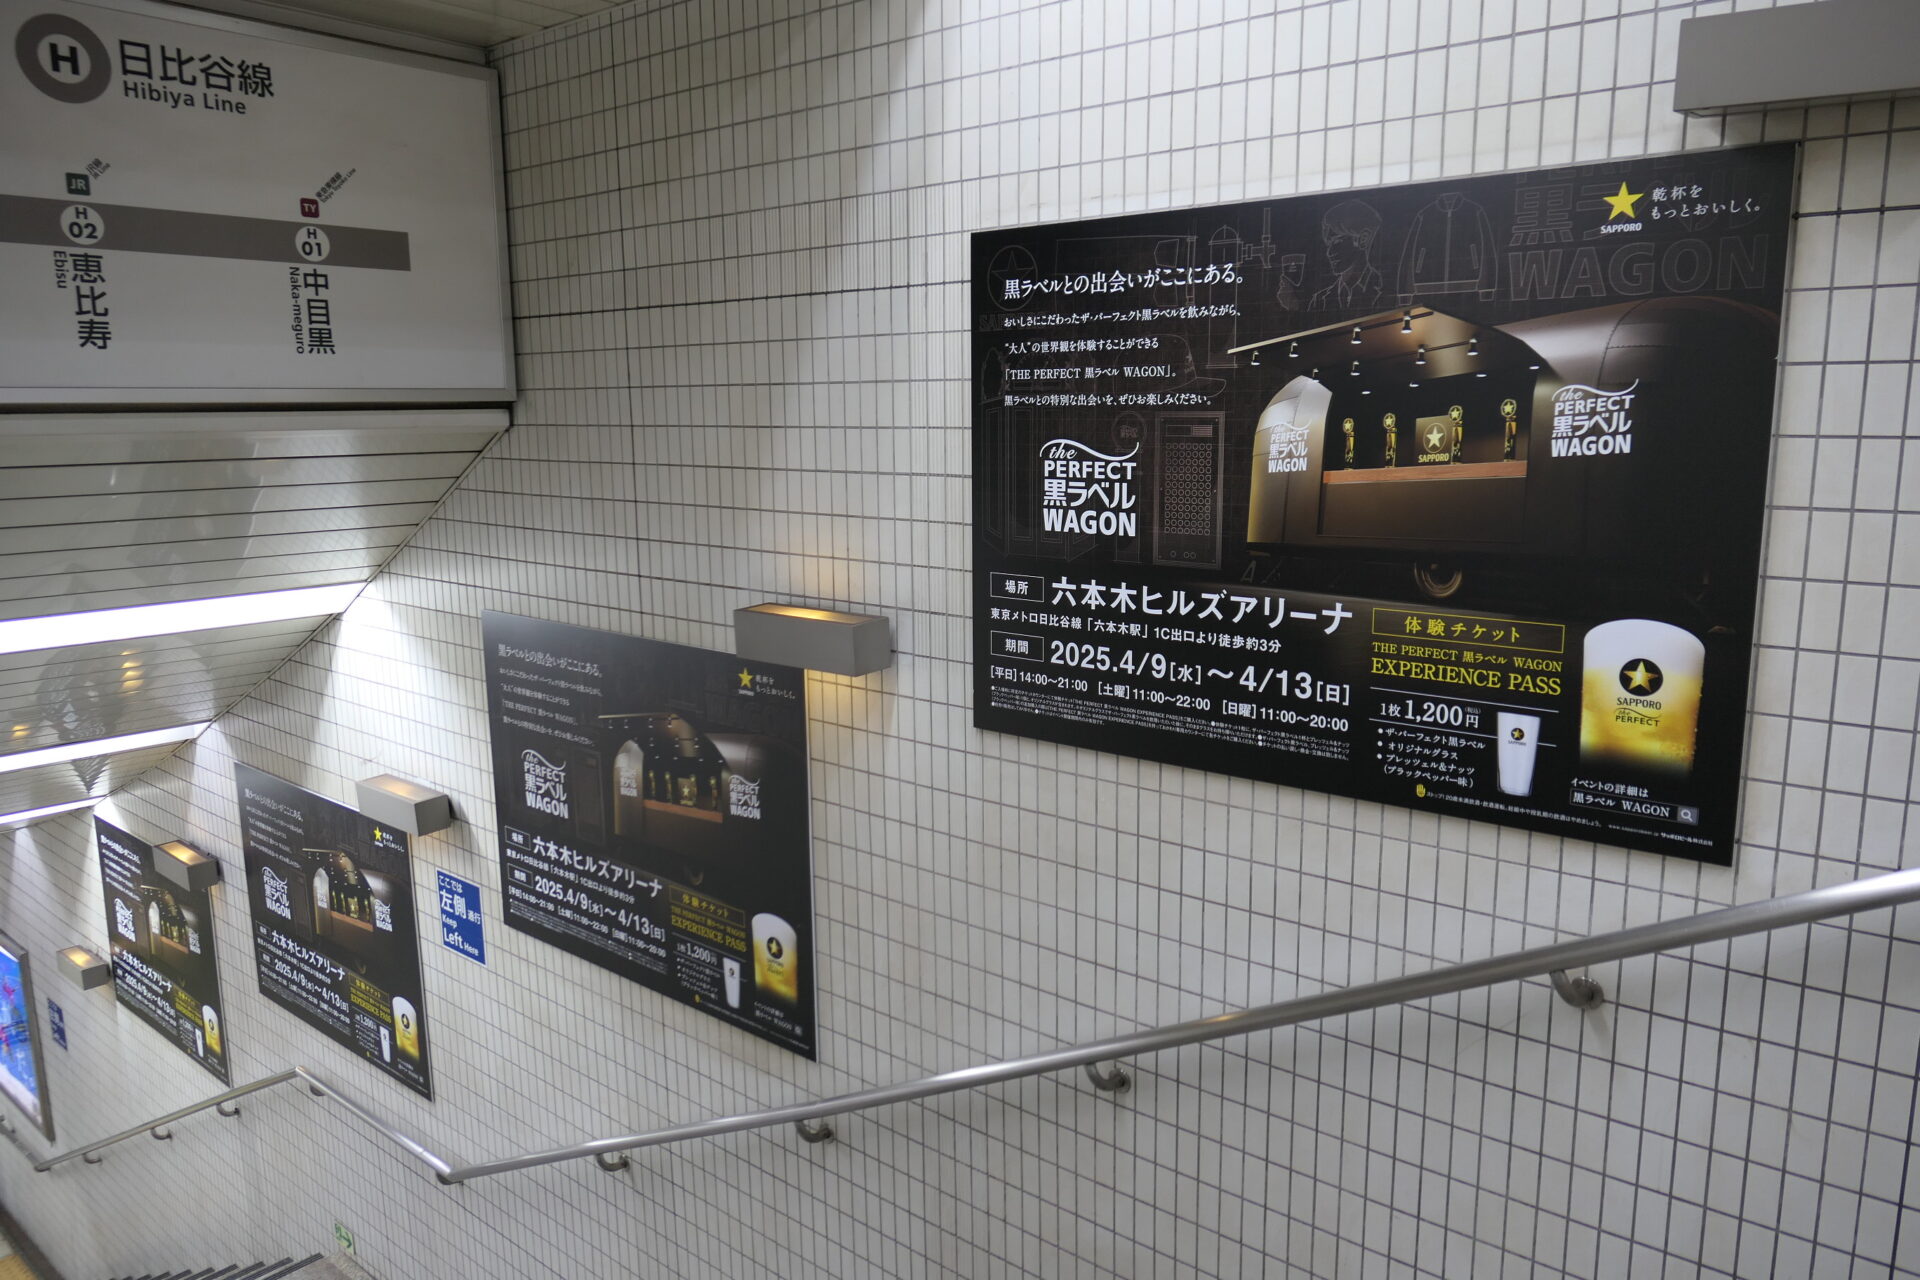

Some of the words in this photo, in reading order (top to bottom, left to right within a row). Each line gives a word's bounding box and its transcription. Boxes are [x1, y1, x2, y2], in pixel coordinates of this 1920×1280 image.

[48, 42, 80, 76] H
[118, 39, 275, 98] 日比谷線
[123, 81, 195, 108] Hibiya
[203, 93, 247, 115] Line
[69, 177, 88, 192] JR
[1652, 184, 1703, 202] 乾杯を
[76, 207, 88, 220] H
[302, 203, 318, 214] TY
[1651, 199, 1761, 220] もっとおいしく。
[69, 222, 98, 240] 02
[306, 228, 318, 239] H
[1601, 222, 1642, 234] SAPPORO
[301, 242, 323, 257] 01
[53, 251, 67, 290] Ebisu
[1508, 234, 1768, 301] WAGON
[1004, 262, 1244, 300] 黒ラベルとの出会いがここにある。
[69, 252, 112, 350] 恵比寿
[288, 266, 305, 355] Naka-meguro
[302, 268, 336, 356] 中目黒
[1034, 367, 1081, 380] PERFECT
[1084, 366, 1120, 379] 黒ラベル
[1553, 395, 1635, 415] PERFECT
[1551, 412, 1632, 438] 黒ラベル
[1269, 429, 1310, 444] PERFECT
[1550, 434, 1632, 458] WAGON
[1048, 442, 1077, 459] the
[1268, 442, 1309, 459] 黒ラベル
[1417, 453, 1450, 464] SAPPORO
[1044, 460, 1137, 480] PERFECT
[1267, 459, 1308, 473] WAGON
[1043, 478, 1136, 509] 黒ラベル
[1043, 508, 1137, 537] WAGON
[1005, 580, 1029, 595] 場所
[1052, 576, 1353, 635] 六本木ヒルズアリーナ
[1404, 615, 1521, 643] 体験チケット
[1005, 638, 1030, 655] 期間
[1372, 641, 1398, 655] THE
[1401, 644, 1458, 660] PERFECT
[1462, 650, 1507, 665] 黒ラベル
[1513, 656, 1563, 673] WAGON
[1371, 658, 1501, 689] EXPERIENCE
[1508, 674, 1561, 696] PASS
[1616, 696, 1662, 711] SAPPORO
[1615, 714, 1661, 727] PERFECT
[1387, 740, 1459, 761] オリジナルグラス
[523, 761, 566, 784] PERFECT
[524, 772, 567, 802] 黒ラベル
[729, 780, 759, 798] PERFECT
[1570, 777, 1650, 799] イベントの詳細は
[525, 790, 568, 819] WAGON
[730, 801, 761, 822] WAGON
[1572, 791, 1616, 808] 黒ラベル
[1621, 801, 1670, 819] WAGON
[532, 835, 662, 898] 六本木ヒルズアリーナ
[439, 875, 463, 893] ここでは
[265, 896, 291, 920] WAGON
[444, 927, 463, 949] Left
[464, 942, 479, 956] Here
[671, 915, 723, 944] EXPERIENCE
[726, 933, 747, 952] PASS
[271, 929, 345, 981] 六本木ヒルズアリーナ
